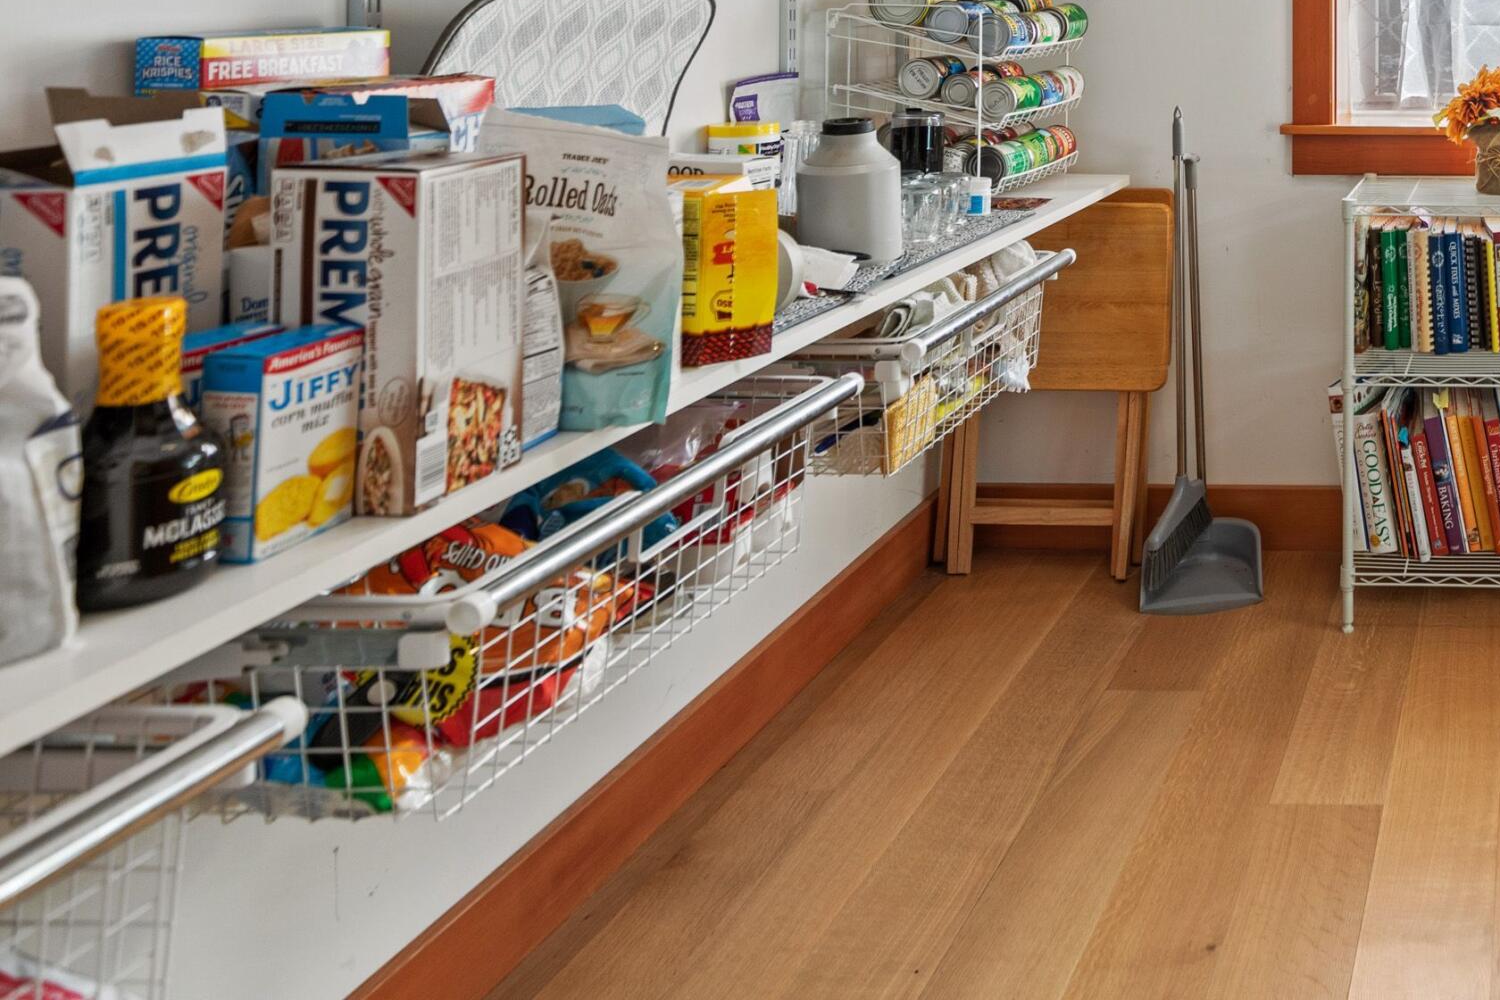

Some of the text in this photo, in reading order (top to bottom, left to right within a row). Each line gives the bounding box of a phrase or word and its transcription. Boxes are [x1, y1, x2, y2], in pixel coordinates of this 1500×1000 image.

[153, 56, 182, 67] RICE
[229, 36, 327, 55] LARGE SIZE
[142, 66, 193, 81] KRISPIES
[207, 54, 345, 81] FREE BREAKFAST
[525, 173, 619, 217] Rolled Oats
[133, 183, 182, 300] PRE
[319, 181, 371, 328] PREM
[369, 216, 395, 264] whole
[1449, 241, 1458, 265] QUICK
[366, 268, 391, 321] grain
[1450, 266, 1458, 285] FIXES
[268, 331, 364, 371] America's Favorite
[267, 363, 359, 412] JIFFY
[271, 391, 355, 429] corn muffin
[301, 415, 331, 434] mix
[1362, 439, 1393, 548] GOOD EASY
[1437, 485, 1454, 530] BAKING
[441, 540, 486, 570] CHIPS
